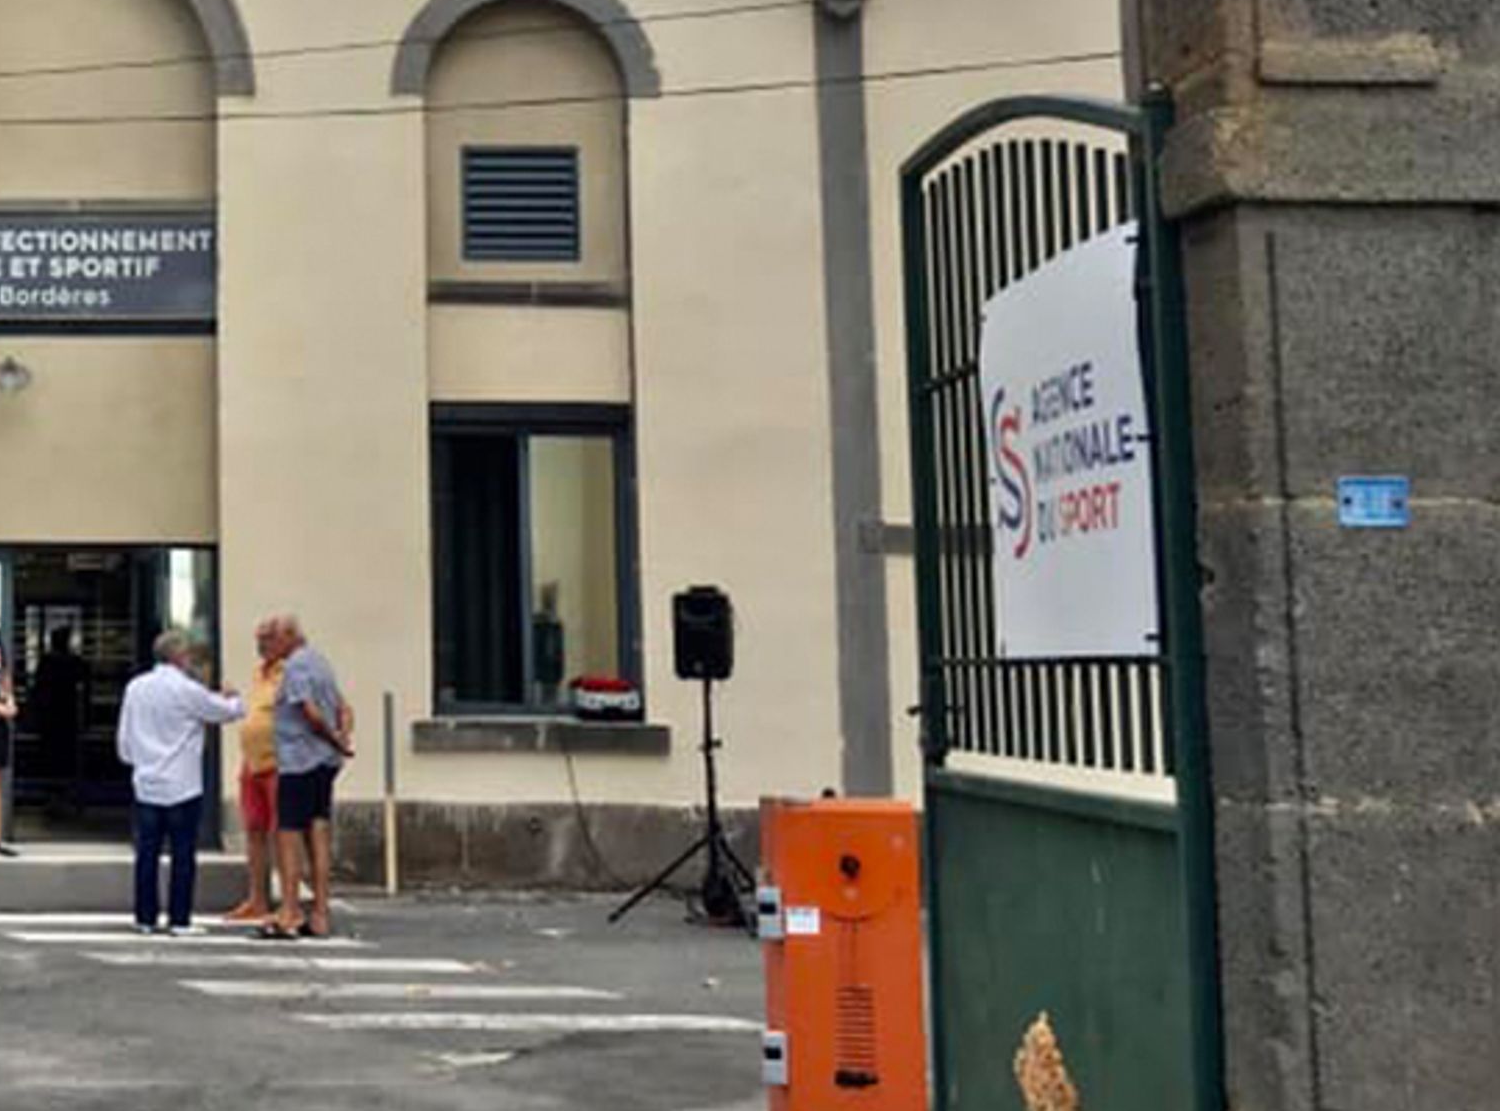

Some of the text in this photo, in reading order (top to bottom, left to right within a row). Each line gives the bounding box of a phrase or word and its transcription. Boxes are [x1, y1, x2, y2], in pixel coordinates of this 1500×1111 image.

[11, 256, 41, 277] ET
[49, 256, 160, 277] SPORTIF
[1032, 362, 1094, 425] AGENCE
[1034, 415, 1135, 481] NATIONALE
[1059, 483, 1121, 537] SPORT
